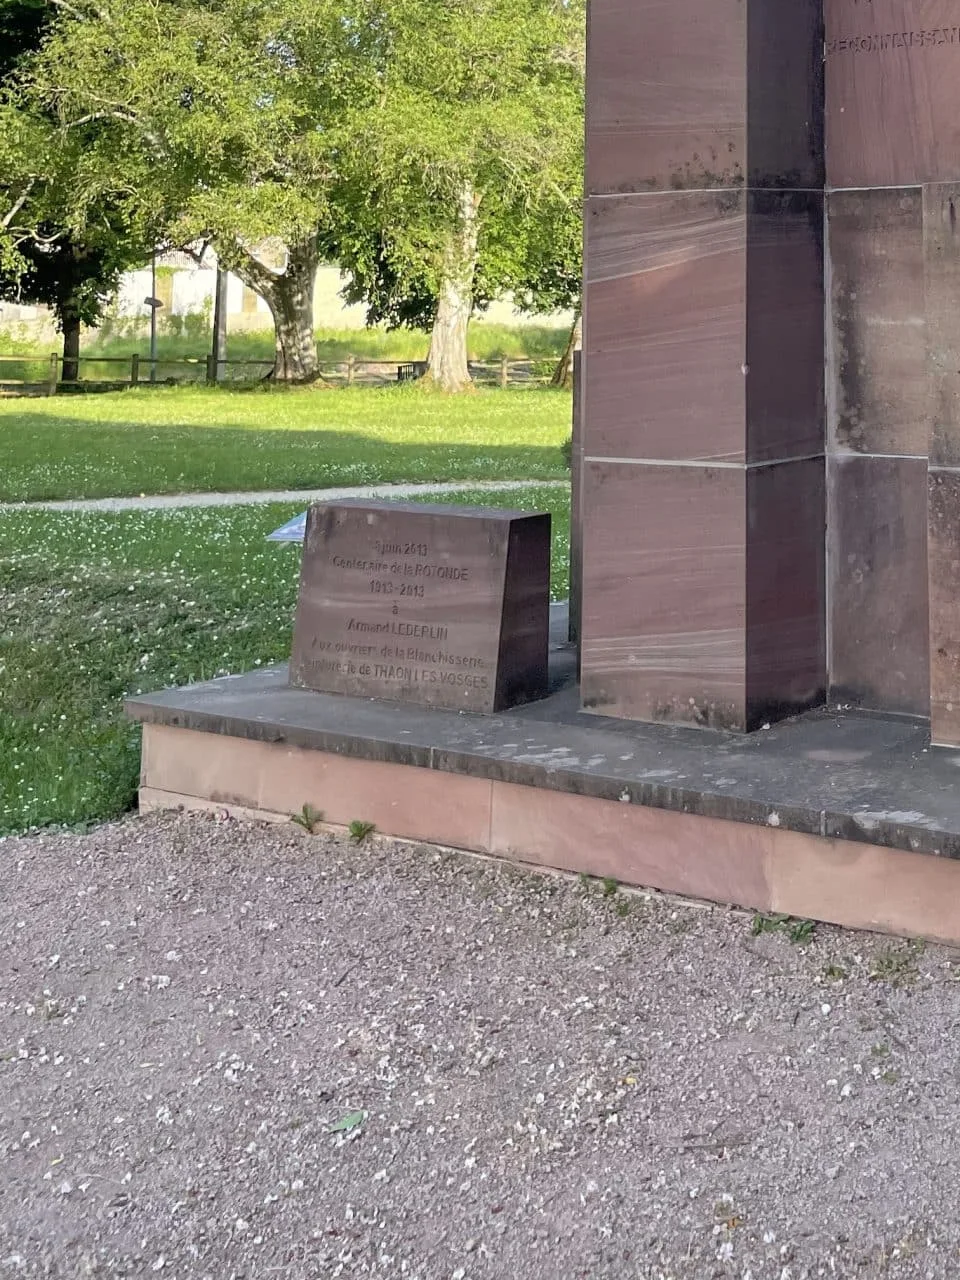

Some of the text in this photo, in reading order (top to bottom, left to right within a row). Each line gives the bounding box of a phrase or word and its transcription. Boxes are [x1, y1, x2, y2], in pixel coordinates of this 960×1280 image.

[381, 543, 402, 556] juin
[404, 543, 428, 557] 2013
[391, 561, 402, 575] de
[404, 563, 413, 576] la
[415, 563, 469, 581] ROTONDE
[347, 618, 448, 641] Armand LEDERLIN
[380, 644, 393, 658] de
[394, 646, 405, 660] la
[359, 663, 371, 675] de
[374, 664, 412, 681] THAON
[414, 667, 437, 683] LES
[440, 671, 489, 689] VOSGES
